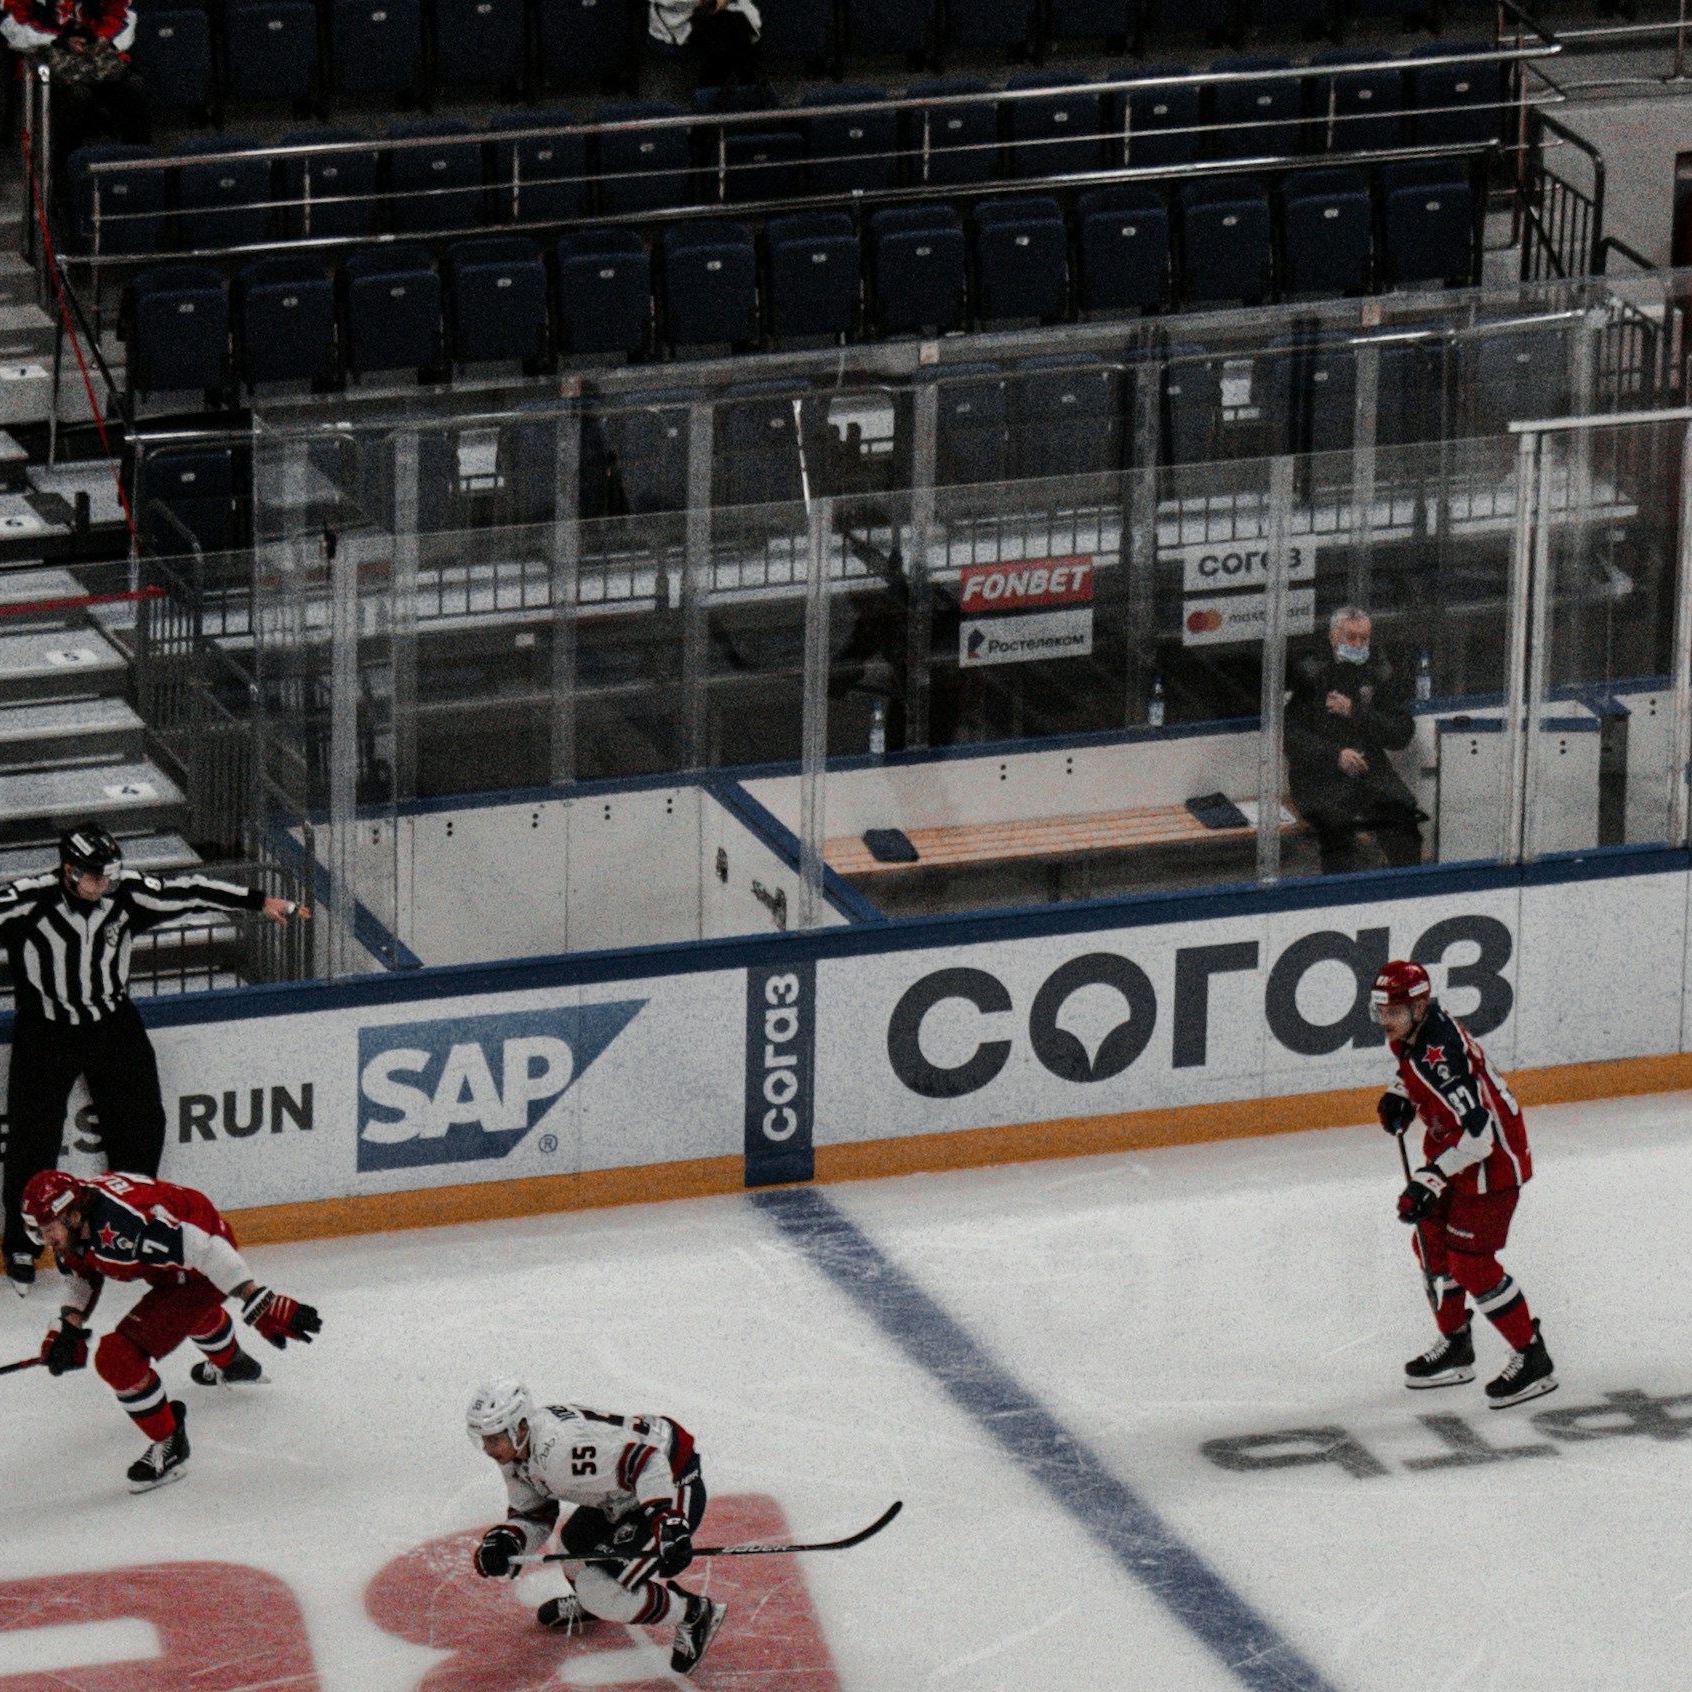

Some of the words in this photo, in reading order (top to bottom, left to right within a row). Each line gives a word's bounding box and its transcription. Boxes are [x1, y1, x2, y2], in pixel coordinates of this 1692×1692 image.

[962, 564, 1095, 602] FONBET
[988, 633, 1085, 655] Ростелеком
[360, 1036, 575, 1146] SAP
[179, 1082, 314, 1144] RUN
[142, 1238, 169, 1254] 7
[572, 1446, 597, 1476] 55
